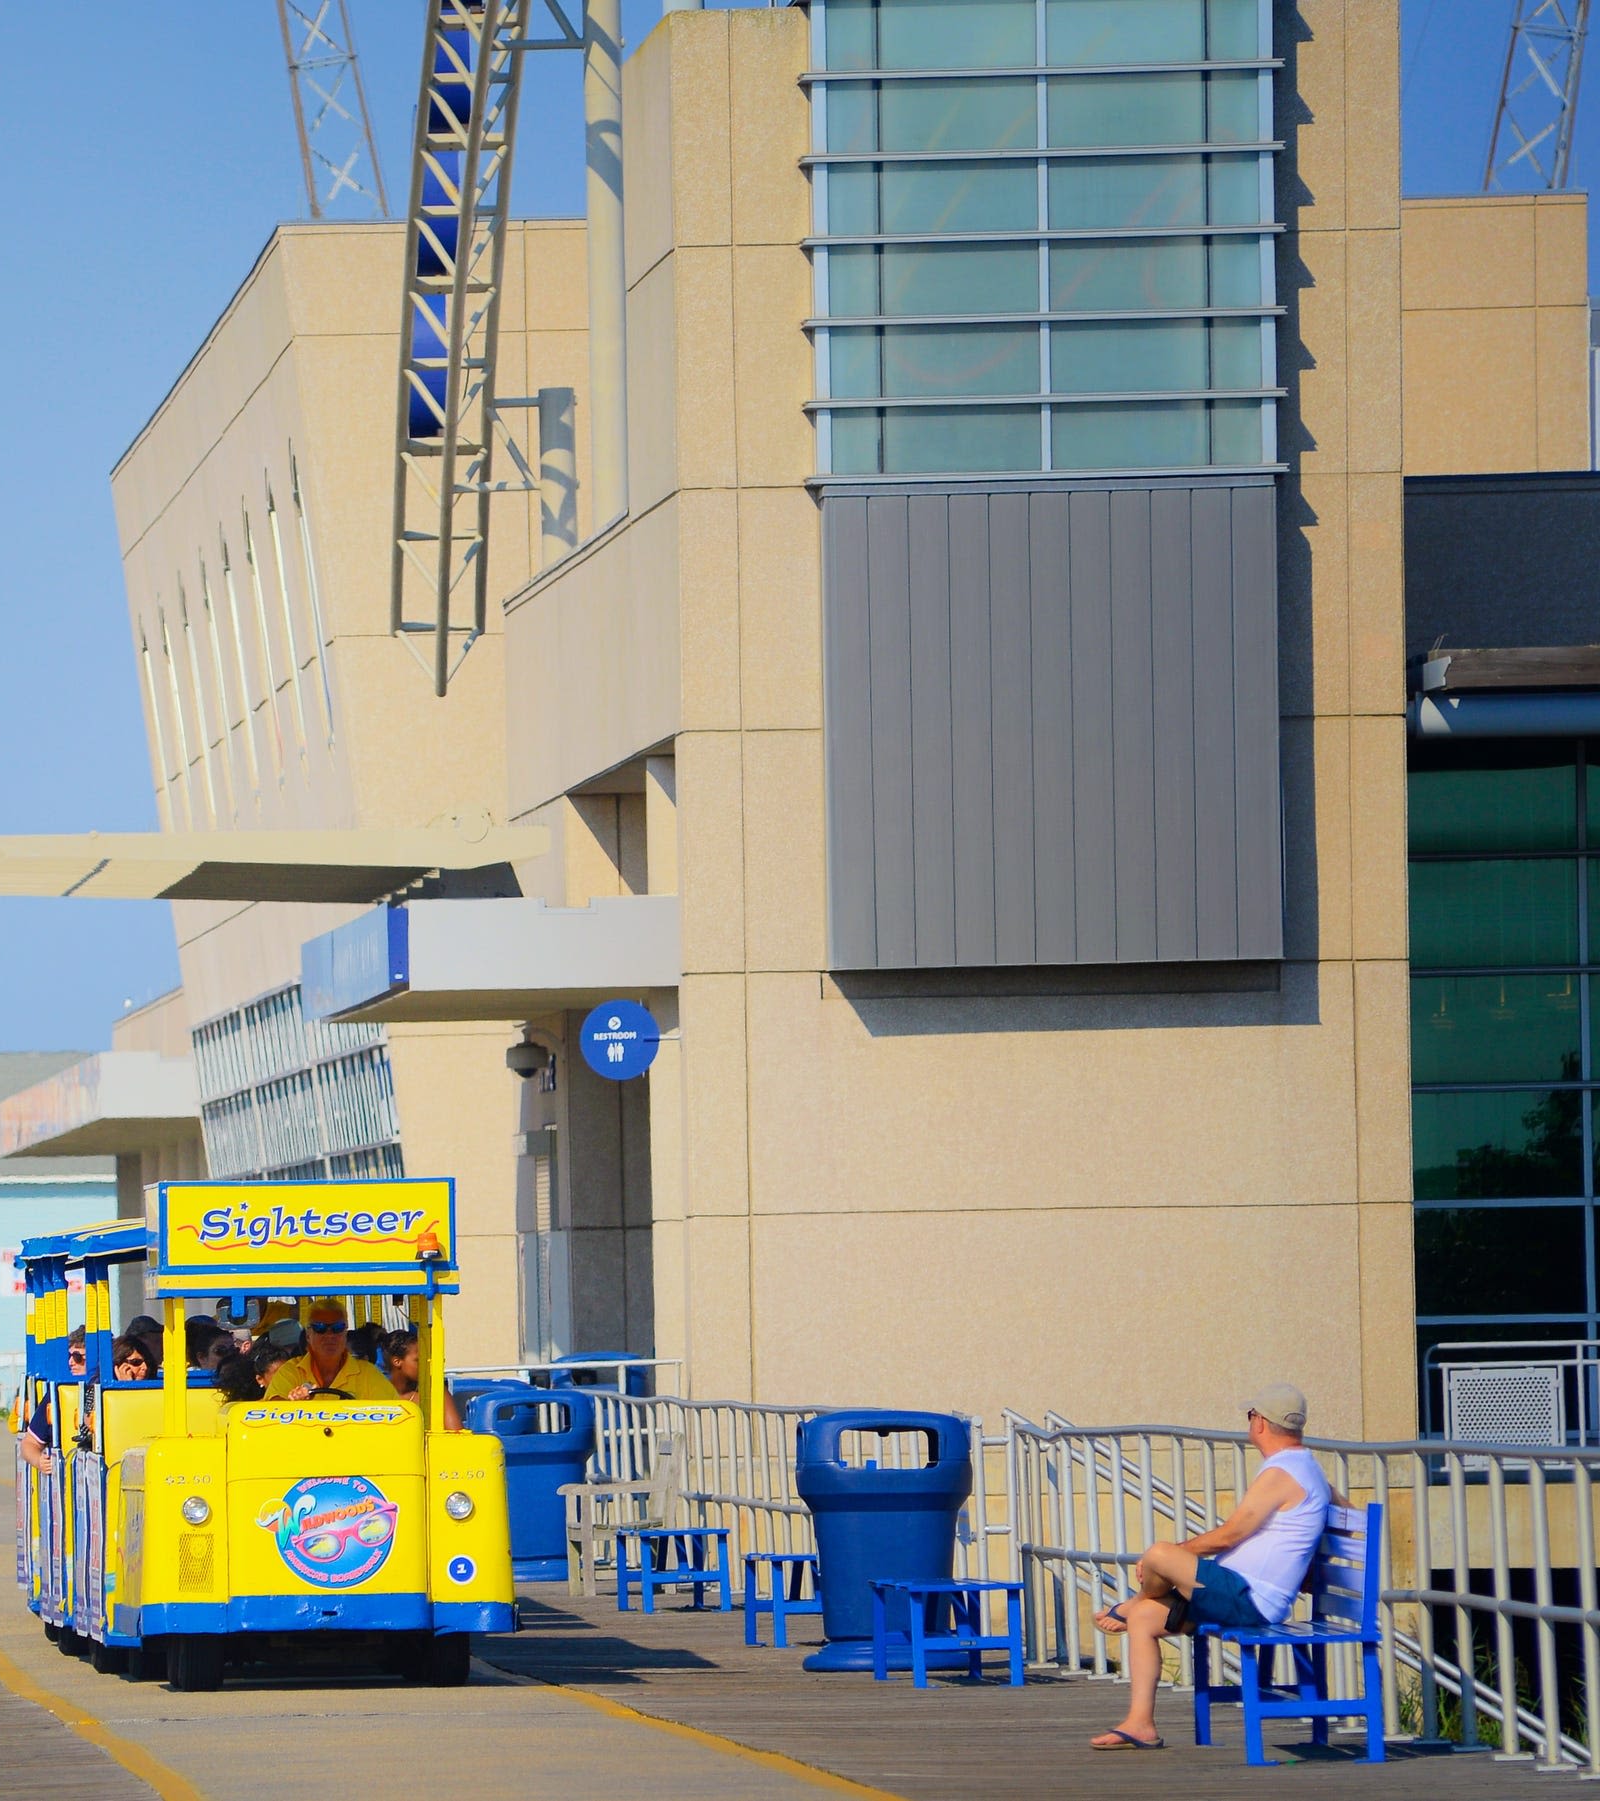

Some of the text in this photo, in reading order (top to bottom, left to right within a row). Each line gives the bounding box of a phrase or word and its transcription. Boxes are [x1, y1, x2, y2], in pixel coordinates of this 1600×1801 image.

[593, 1031, 637, 1041] RESTROOM
[198, 1201, 426, 1247] Sightseer
[244, 1407, 402, 1424] Sightseer
[166, 1475, 211, 1486] $2.50
[439, 1470, 485, 1480] $2.50
[352, 1480, 368, 1493] TO
[456, 1563, 467, 1574] 1
